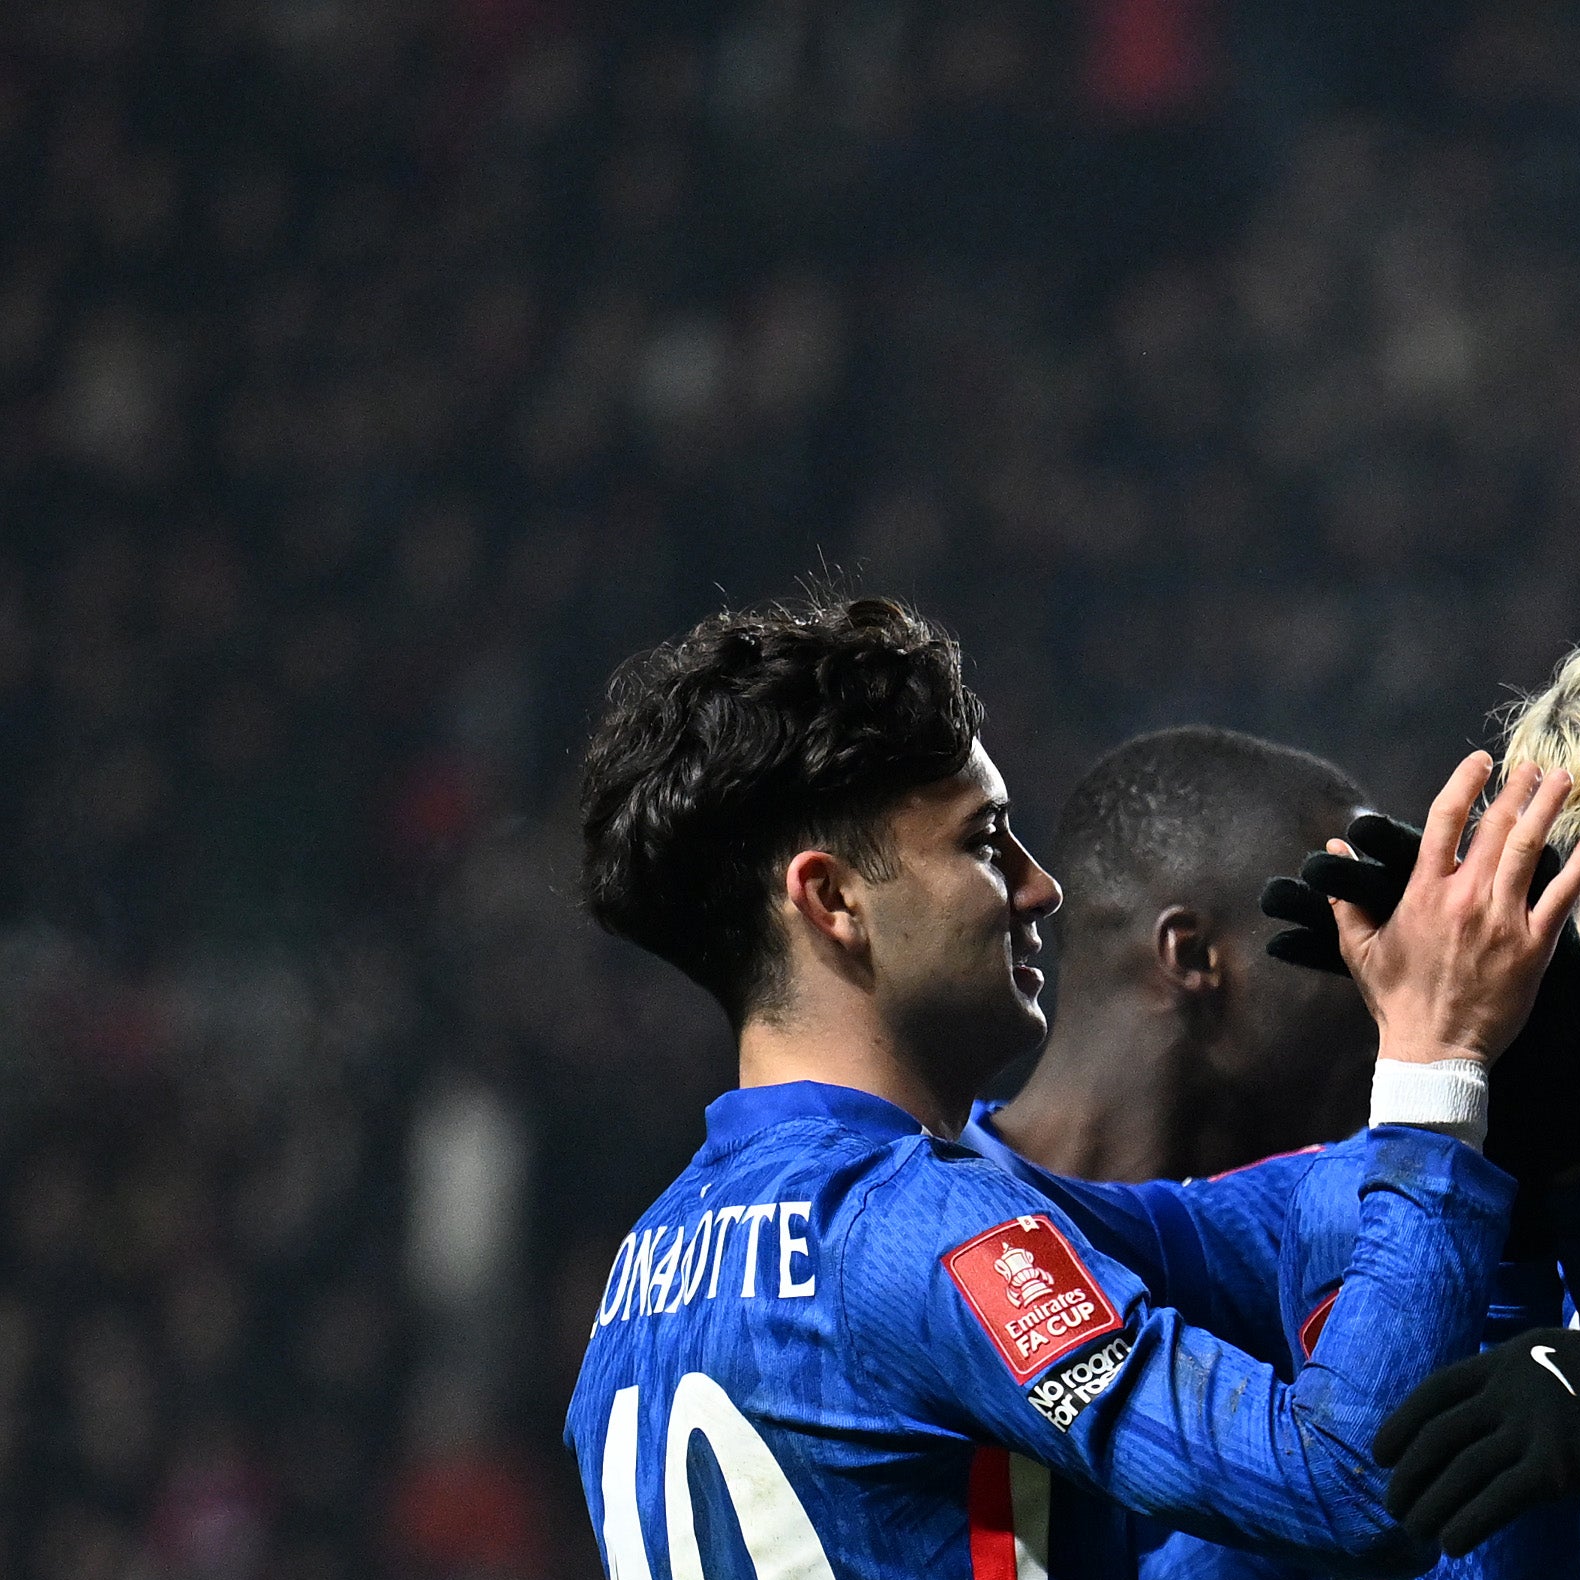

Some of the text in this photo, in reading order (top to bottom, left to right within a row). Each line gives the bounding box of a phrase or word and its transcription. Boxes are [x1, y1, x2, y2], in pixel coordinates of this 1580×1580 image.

[1005, 1288, 1086, 1340] Emirates
[1015, 1302, 1095, 1358] FA CUP
[1028, 1380, 1064, 1417] No
[1060, 1338, 1132, 1389] room
[1047, 1393, 1079, 1433] for
